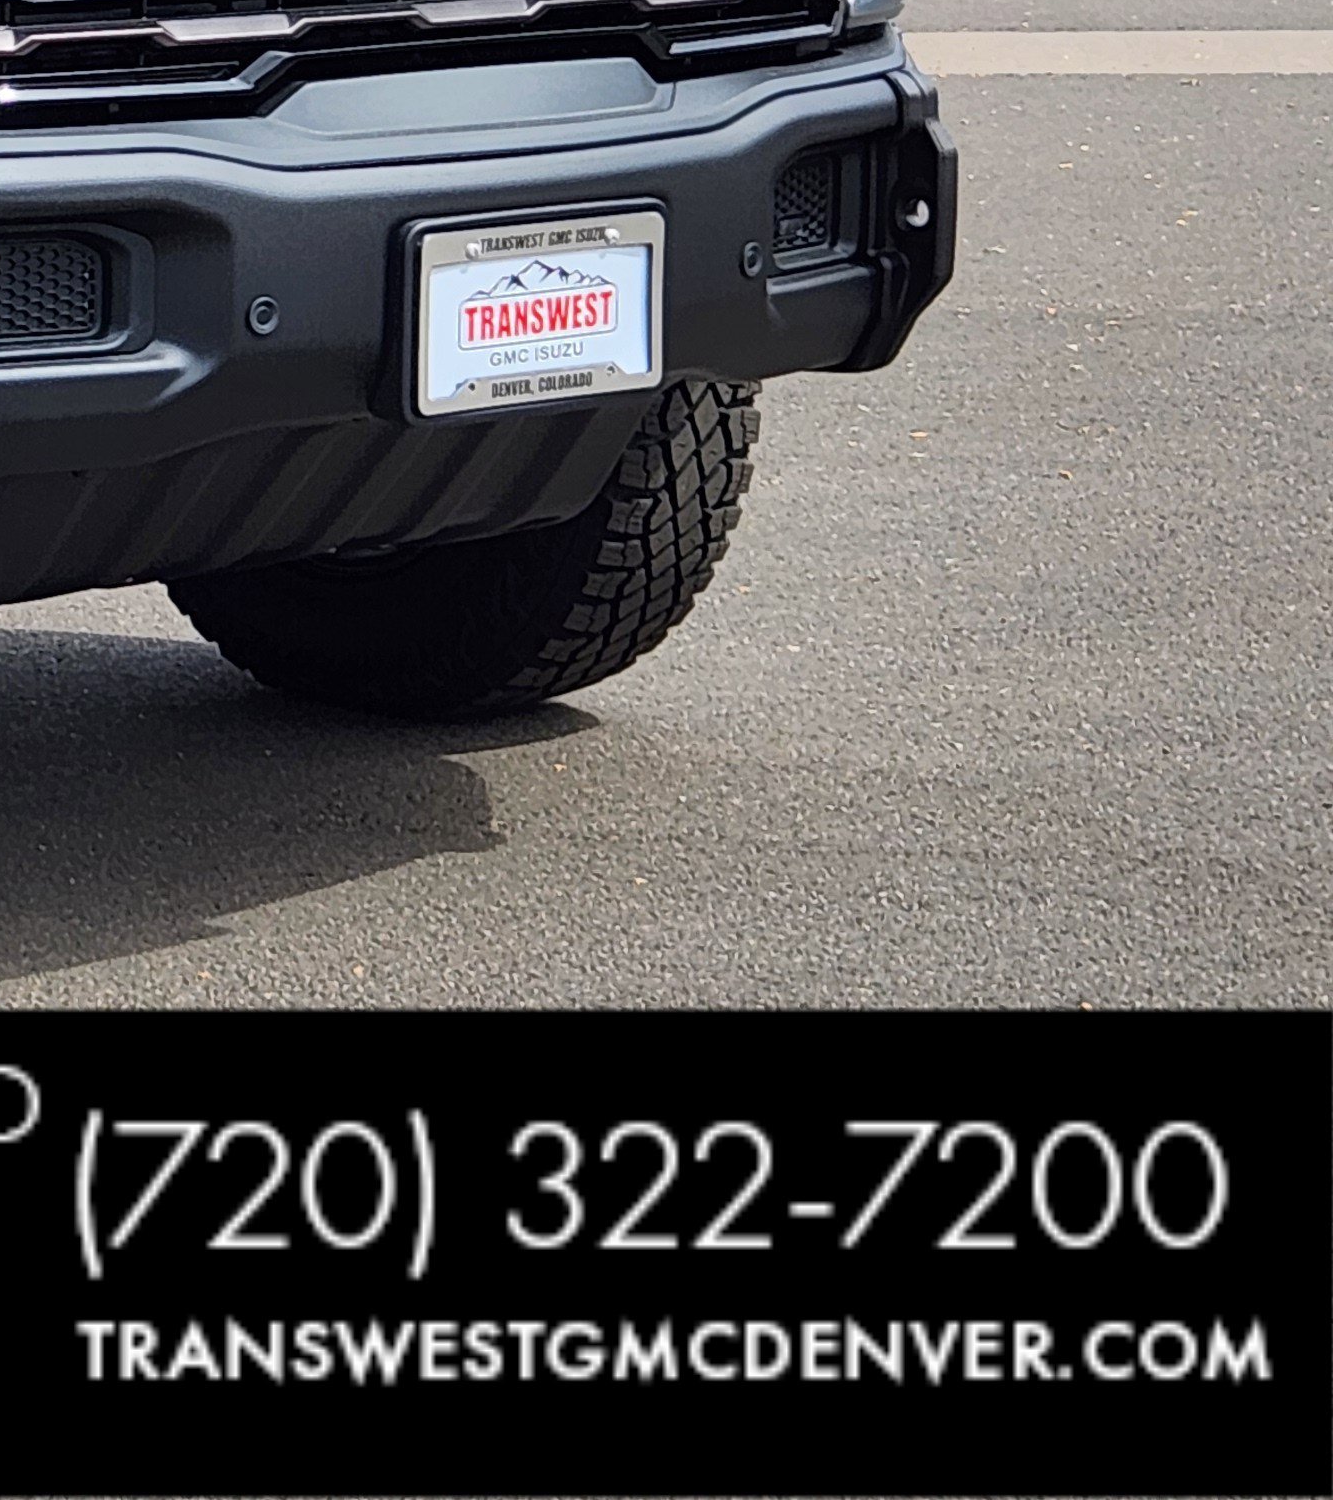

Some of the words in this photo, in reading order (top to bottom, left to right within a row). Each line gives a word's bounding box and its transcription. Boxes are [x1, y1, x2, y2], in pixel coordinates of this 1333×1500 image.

[480, 231, 544, 254] TRANSWEST
[548, 228, 572, 247] GMC
[575, 225, 608, 243] ISUZU
[464, 290, 614, 342] TRANSWEST
[489, 347, 529, 367] GMC
[535, 341, 584, 362] ISUZU
[538, 371, 593, 393] COLORADO
